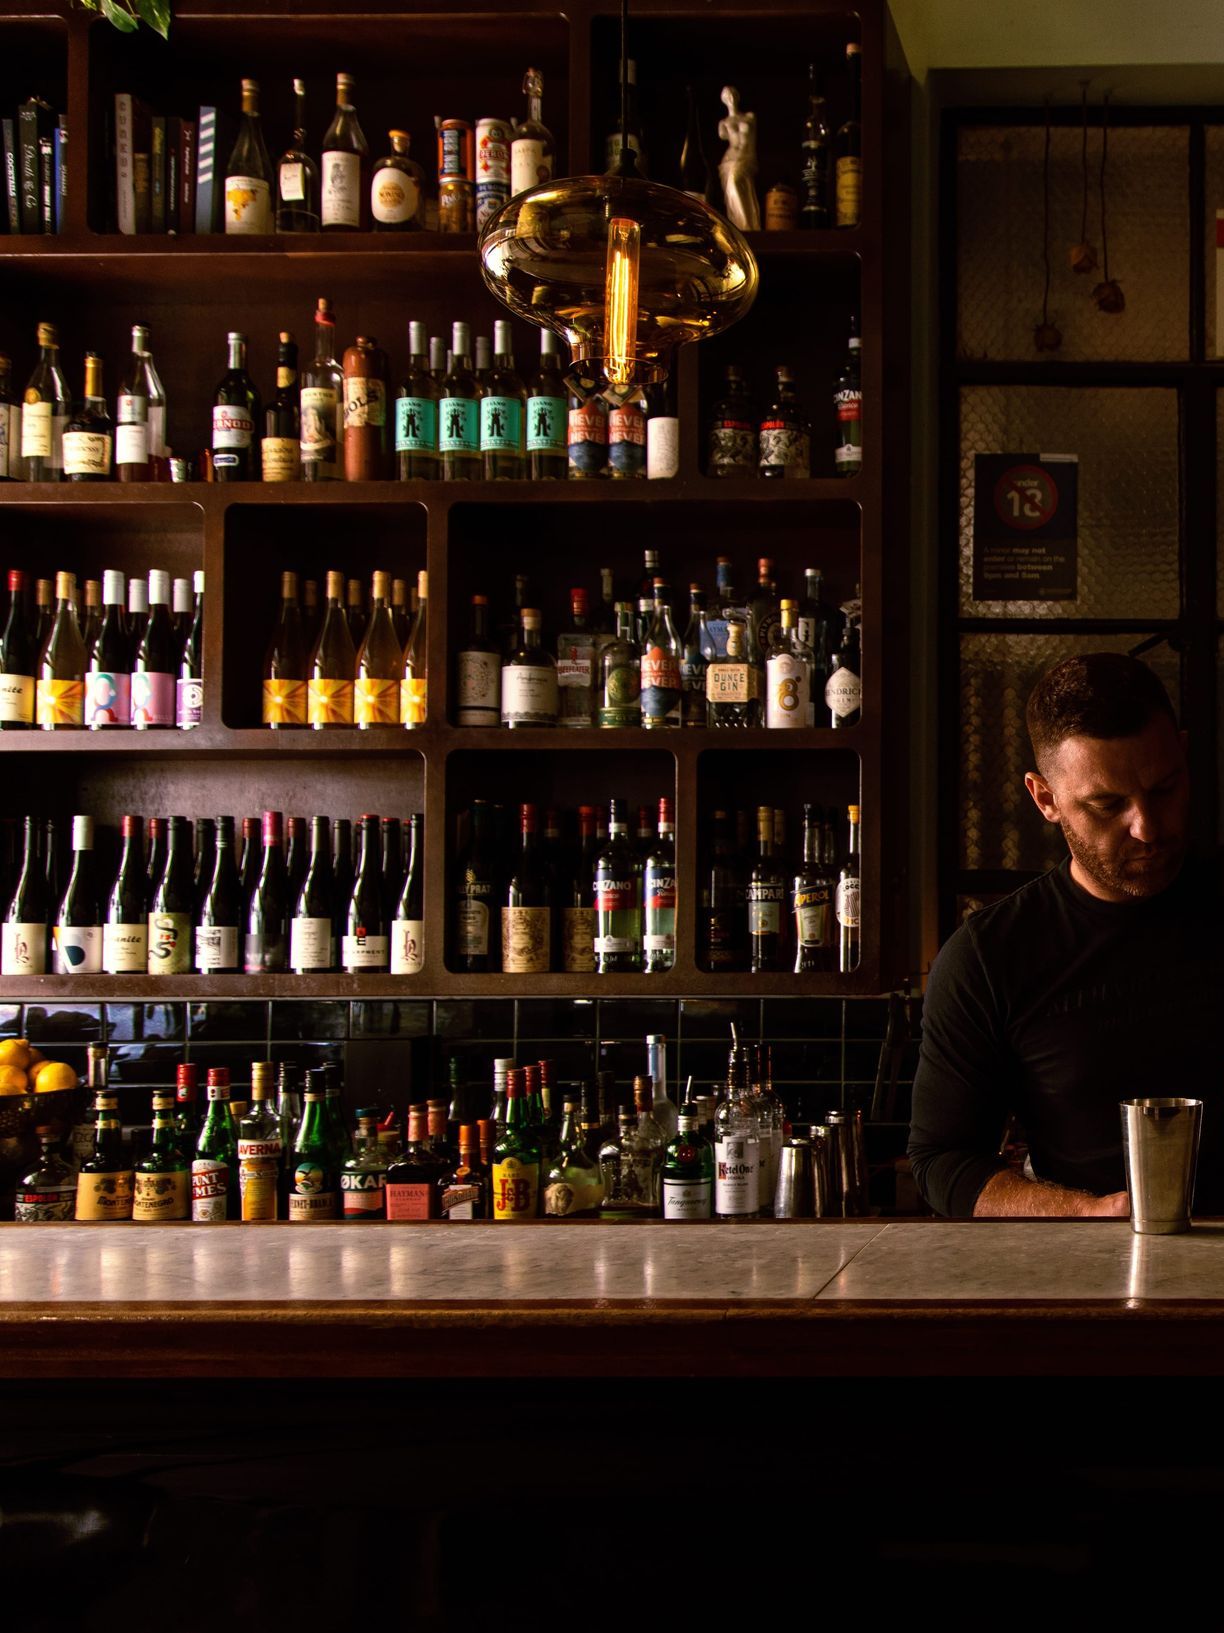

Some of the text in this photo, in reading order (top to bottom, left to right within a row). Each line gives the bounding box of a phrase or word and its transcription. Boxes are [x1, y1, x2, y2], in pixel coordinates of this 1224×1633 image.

[720, 682, 738, 691] GIN
[592, 880, 631, 891] CZANO
[746, 888, 784, 900] CAMPARI
[240, 1142, 281, 1155] AVERNA
[719, 1162, 739, 1180] Ketel
[496, 1178, 530, 1212] J&B
